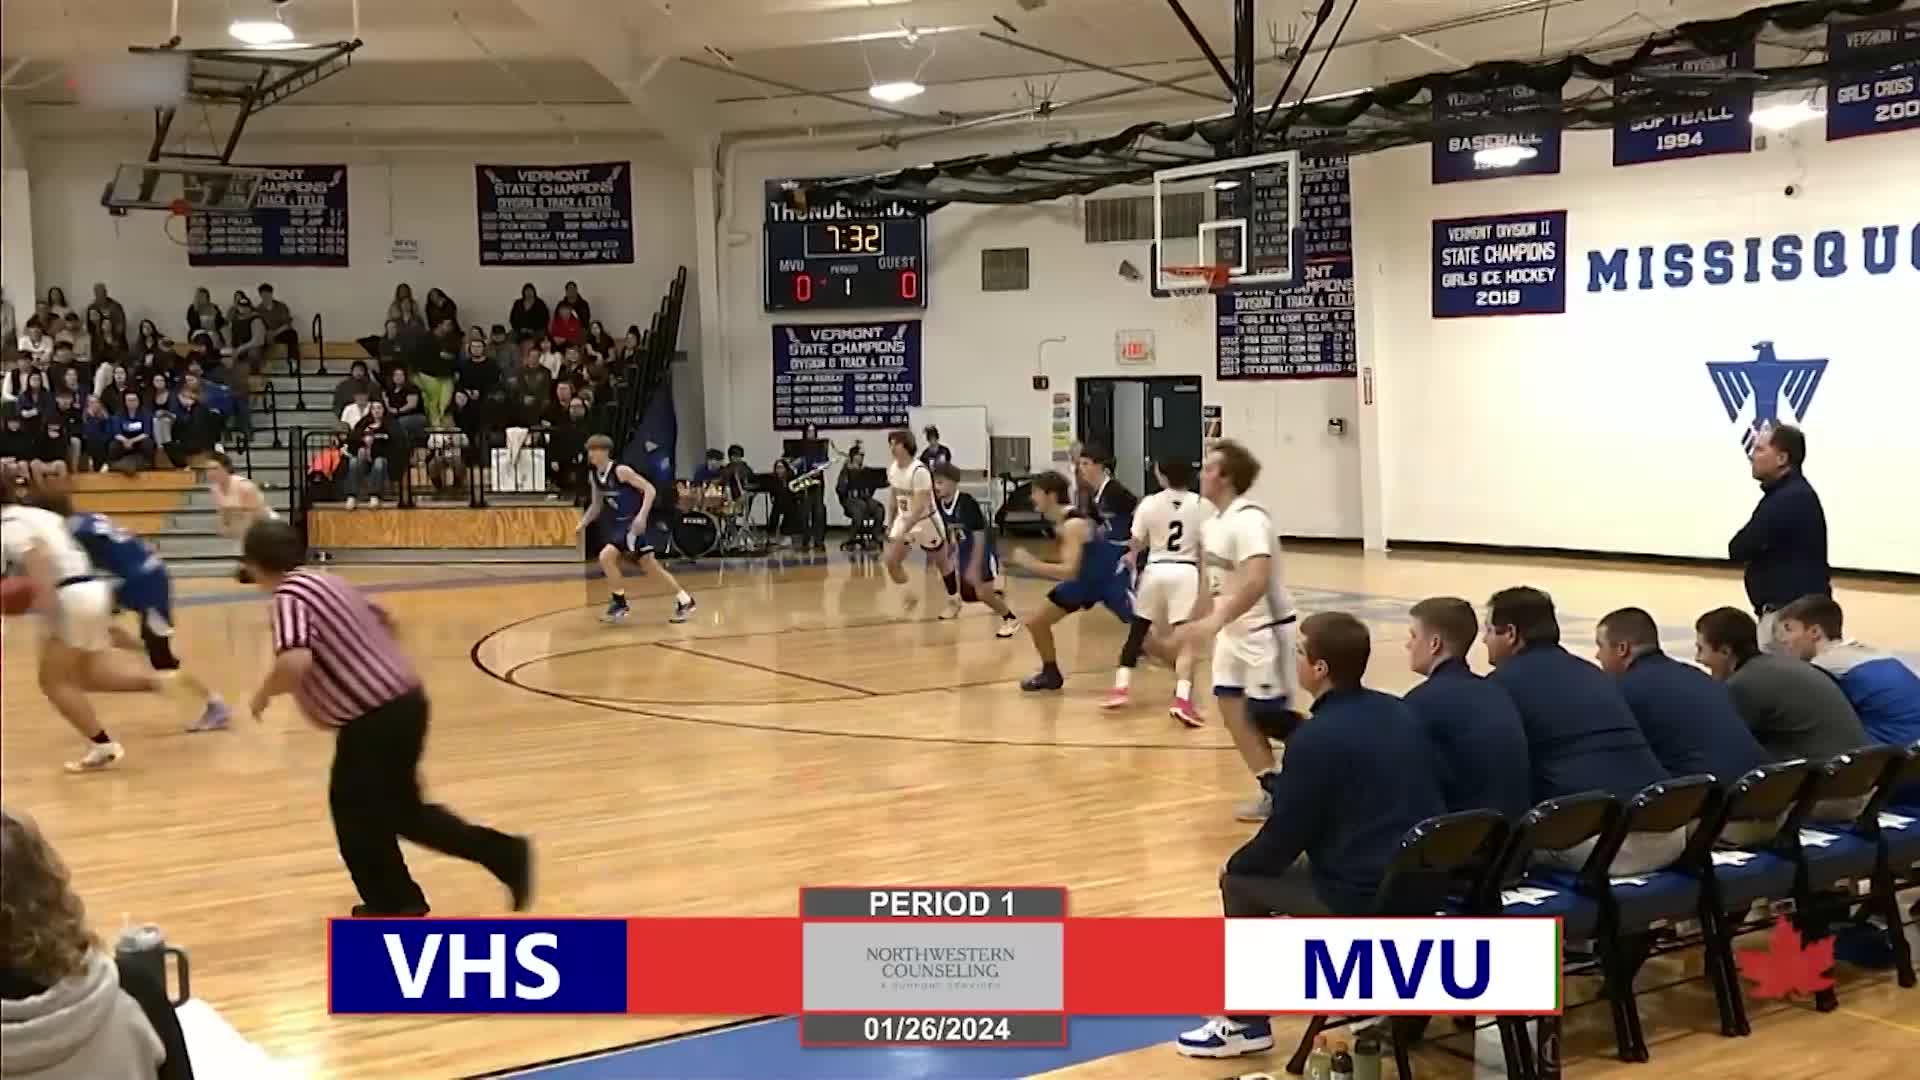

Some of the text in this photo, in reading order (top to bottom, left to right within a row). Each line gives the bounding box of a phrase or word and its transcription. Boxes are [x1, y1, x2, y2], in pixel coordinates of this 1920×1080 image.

[1837, 77, 1914, 104] GIRLS CROSS
[1447, 132, 1543, 152] BASEBALL
[1656, 131, 1704, 151] 1994
[517, 169, 591, 182] VERMONT
[494, 180, 614, 196] STATE CHAMPIONS
[826, 224, 880, 252] 7:32
[1447, 219, 1551, 242] VERMONT DIVISION II
[1441, 241, 1556, 266] STATE CHAMPIONS
[779, 255, 917, 273] MVU GUEST
[796, 271, 917, 302] 0 1 0
[1441, 267, 1556, 288] GIRLS ICE HOCKEY
[811, 327, 884, 342] VERMONT
[788, 340, 906, 357] STATE CHAMPIONS
[879, 354, 905, 367] FIELD
[1167, 520, 1184, 552] 2
